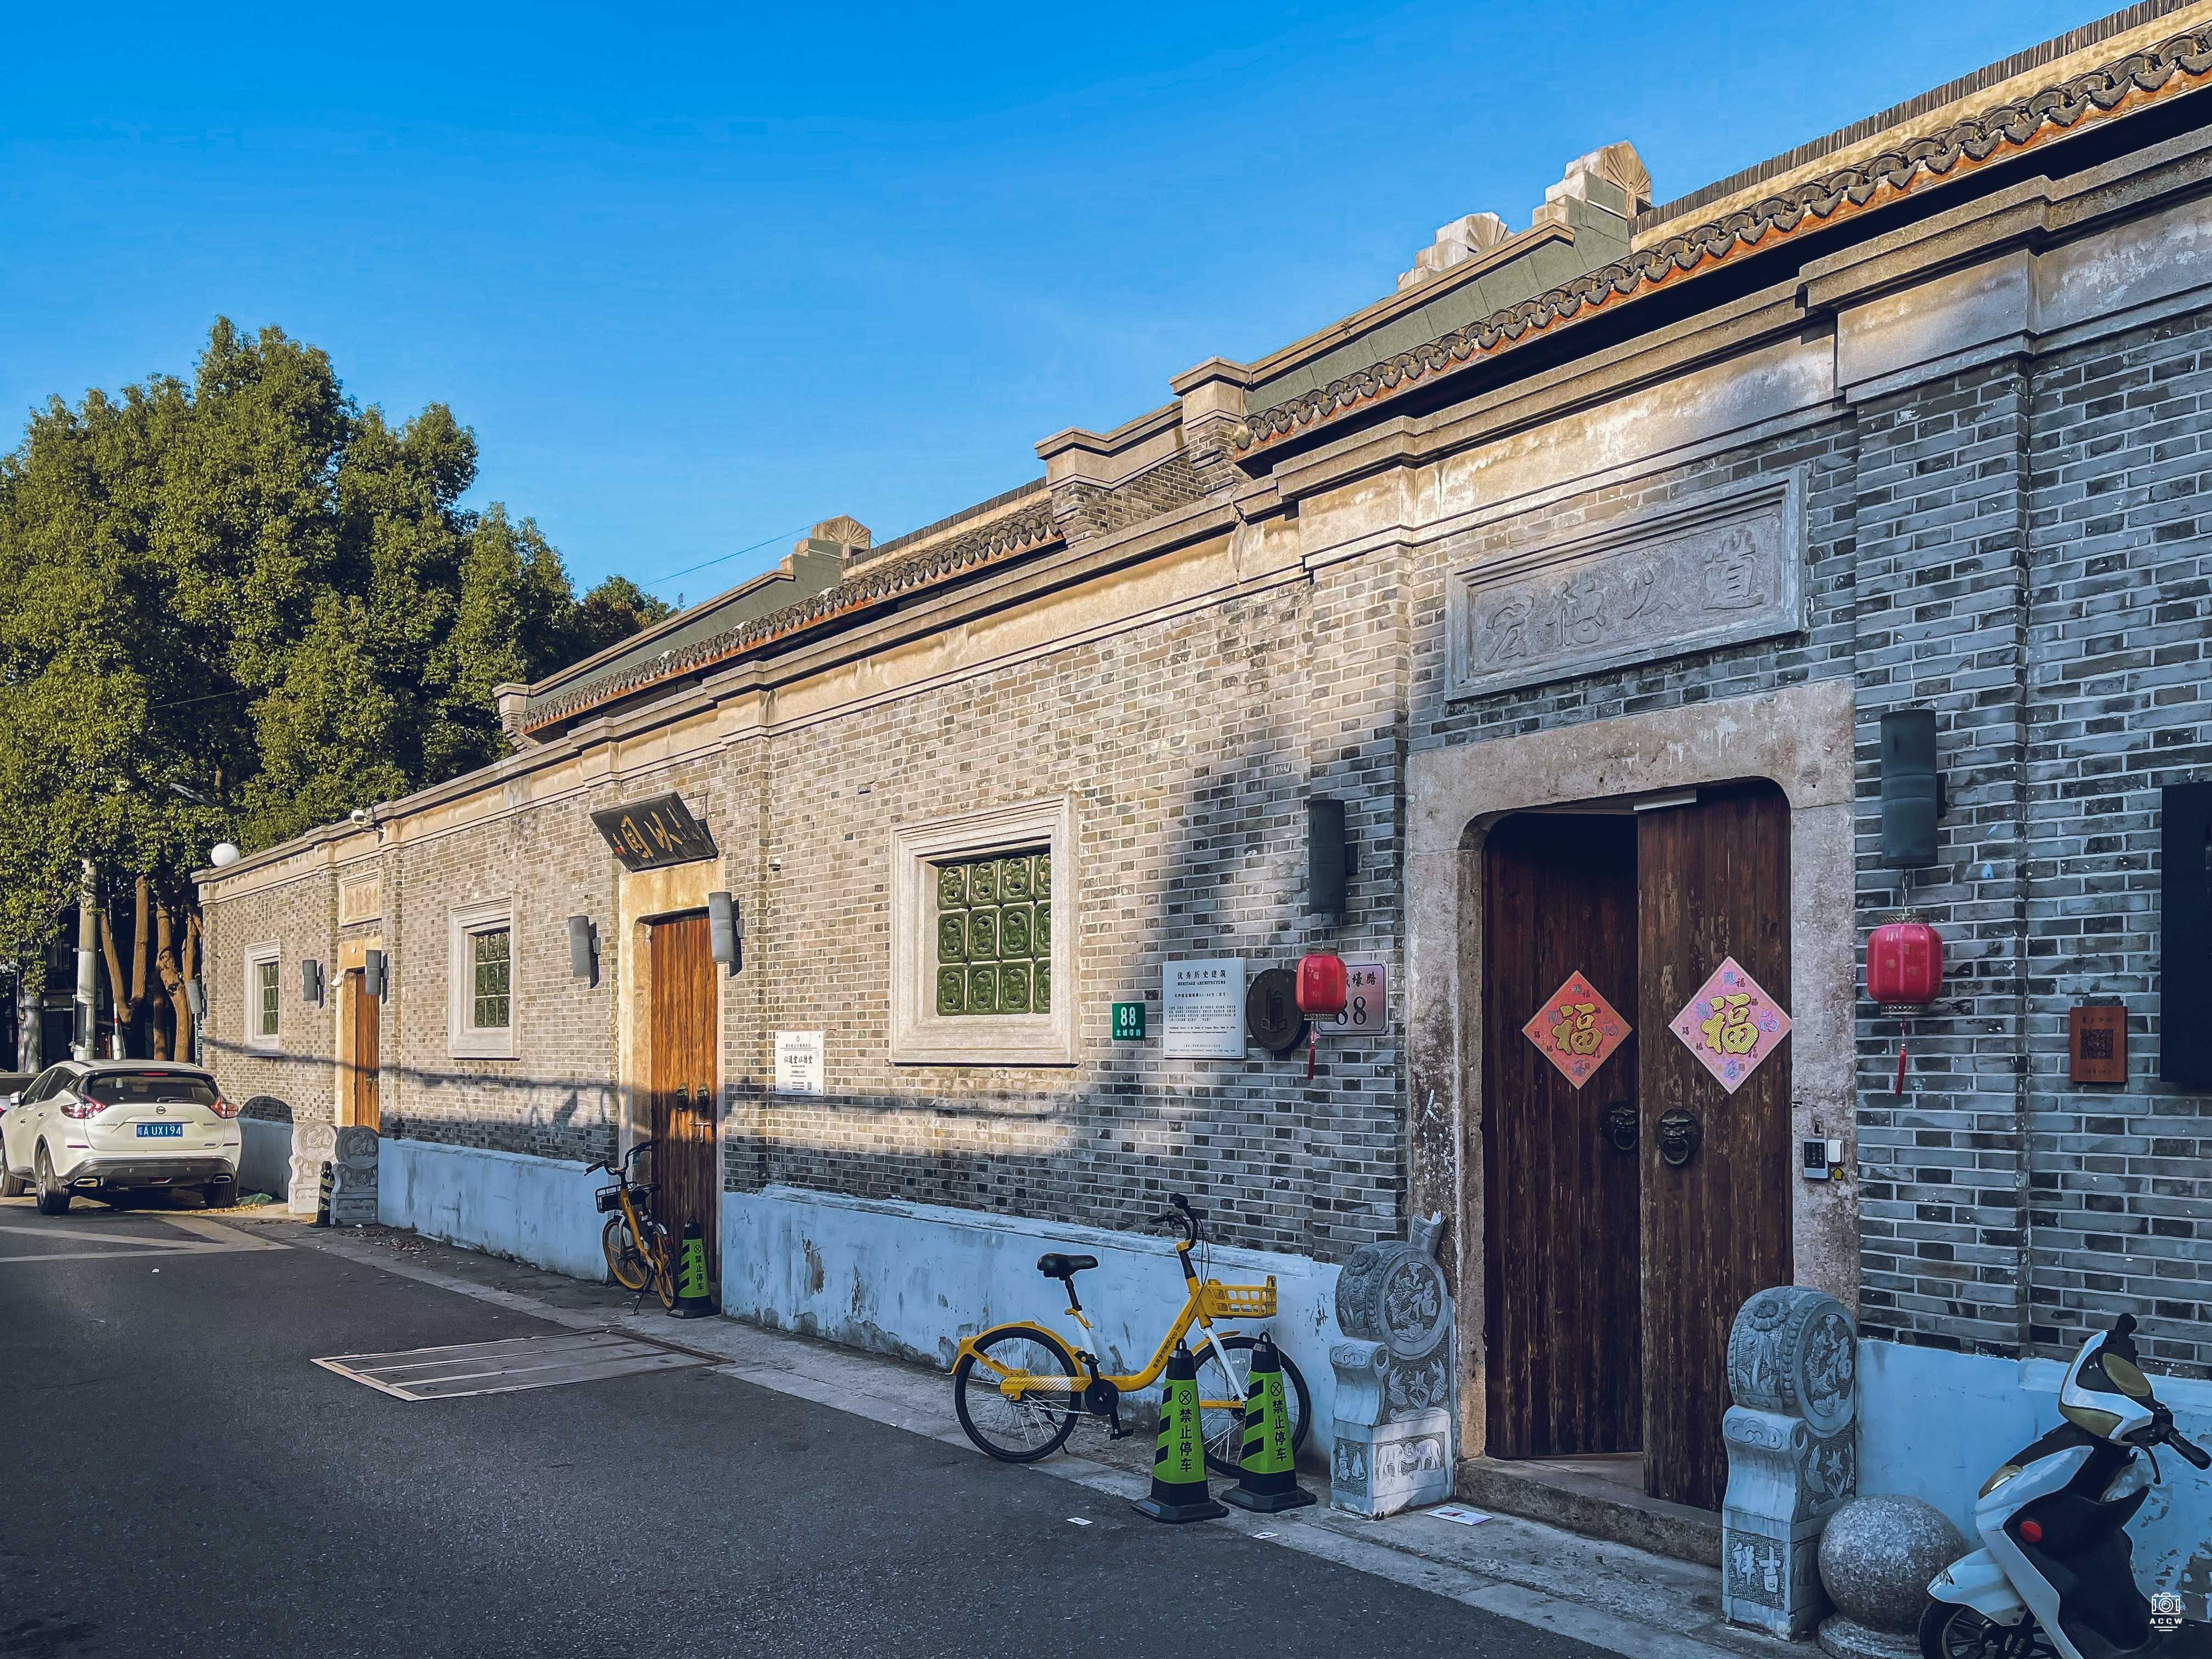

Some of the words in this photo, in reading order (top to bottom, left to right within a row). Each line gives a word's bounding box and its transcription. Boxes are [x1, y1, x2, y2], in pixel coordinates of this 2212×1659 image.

[1177, 969, 1226, 979] 优秀历史建筑
[1120, 1006, 1136, 1026] 88
[1335, 995, 1367, 1026] 88
[1551, 1002, 1603, 1056] 福
[1701, 992, 1760, 1056] 福
[695, 1255, 705, 1291] 禁止停车
[1179, 1408, 1192, 1473] 禁止停车
[1272, 1399, 1287, 1462] 禁止停车
